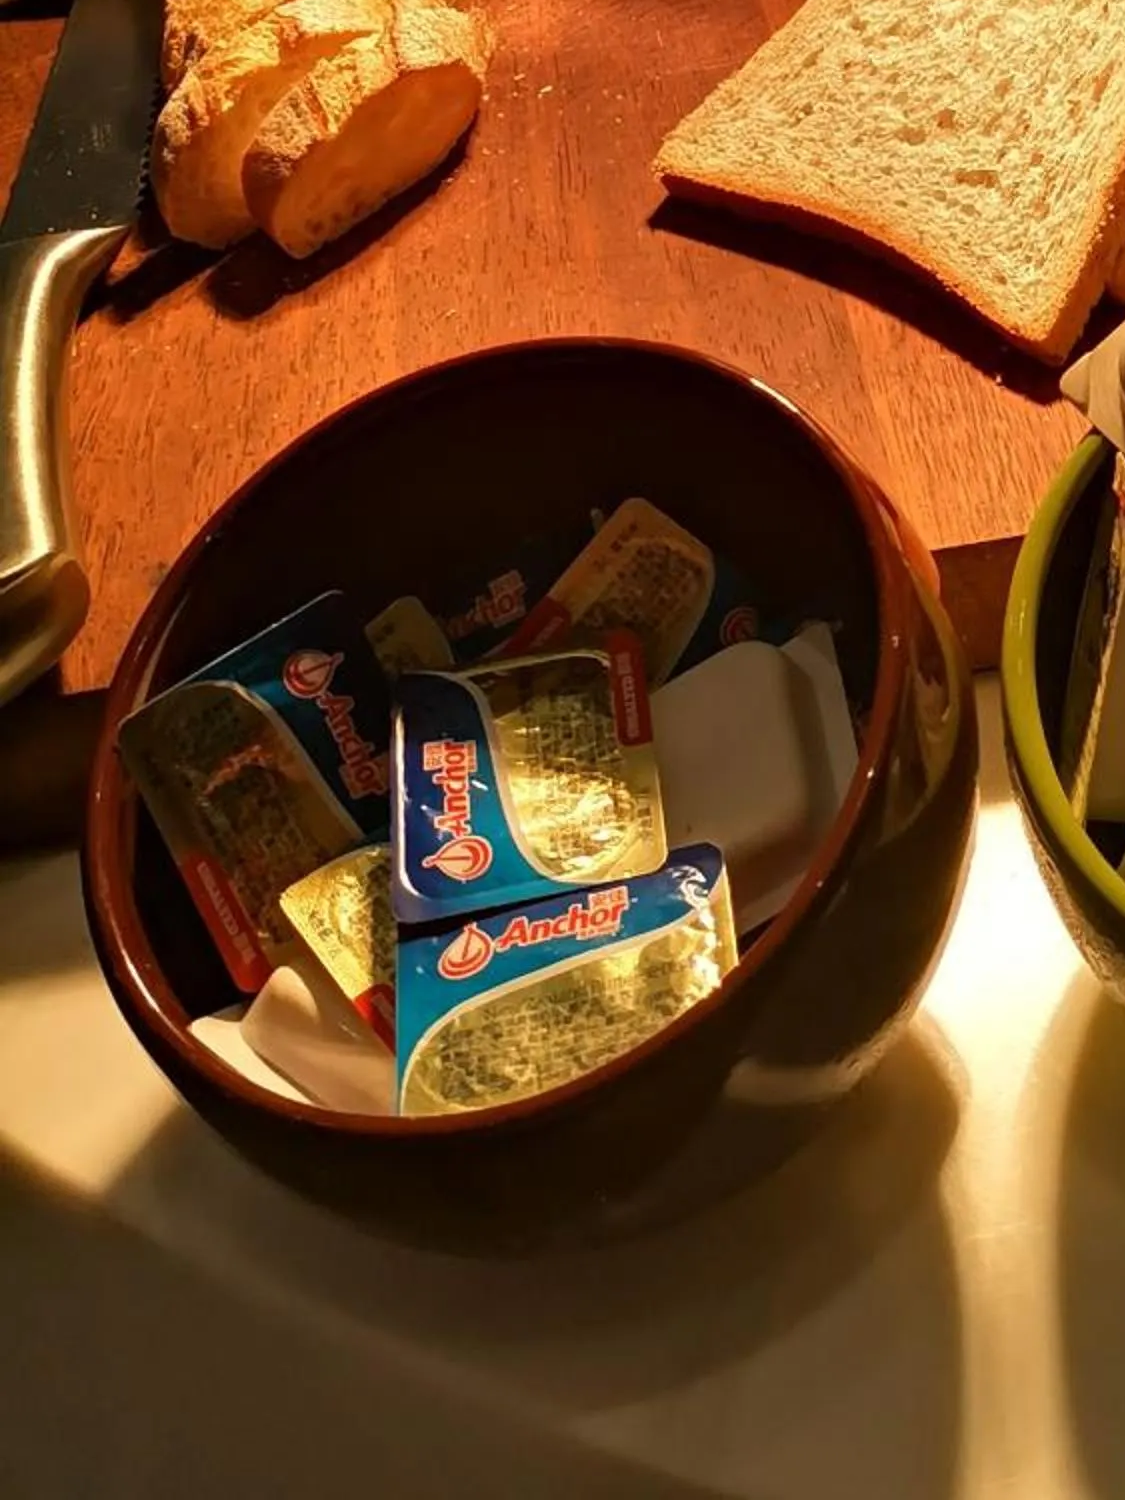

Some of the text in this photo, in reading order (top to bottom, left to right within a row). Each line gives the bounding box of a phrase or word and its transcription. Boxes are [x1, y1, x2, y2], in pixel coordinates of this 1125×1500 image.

[317, 695, 389, 794] Anchor
[434, 738, 471, 841] Anchor
[495, 902, 627, 951] Anchor
